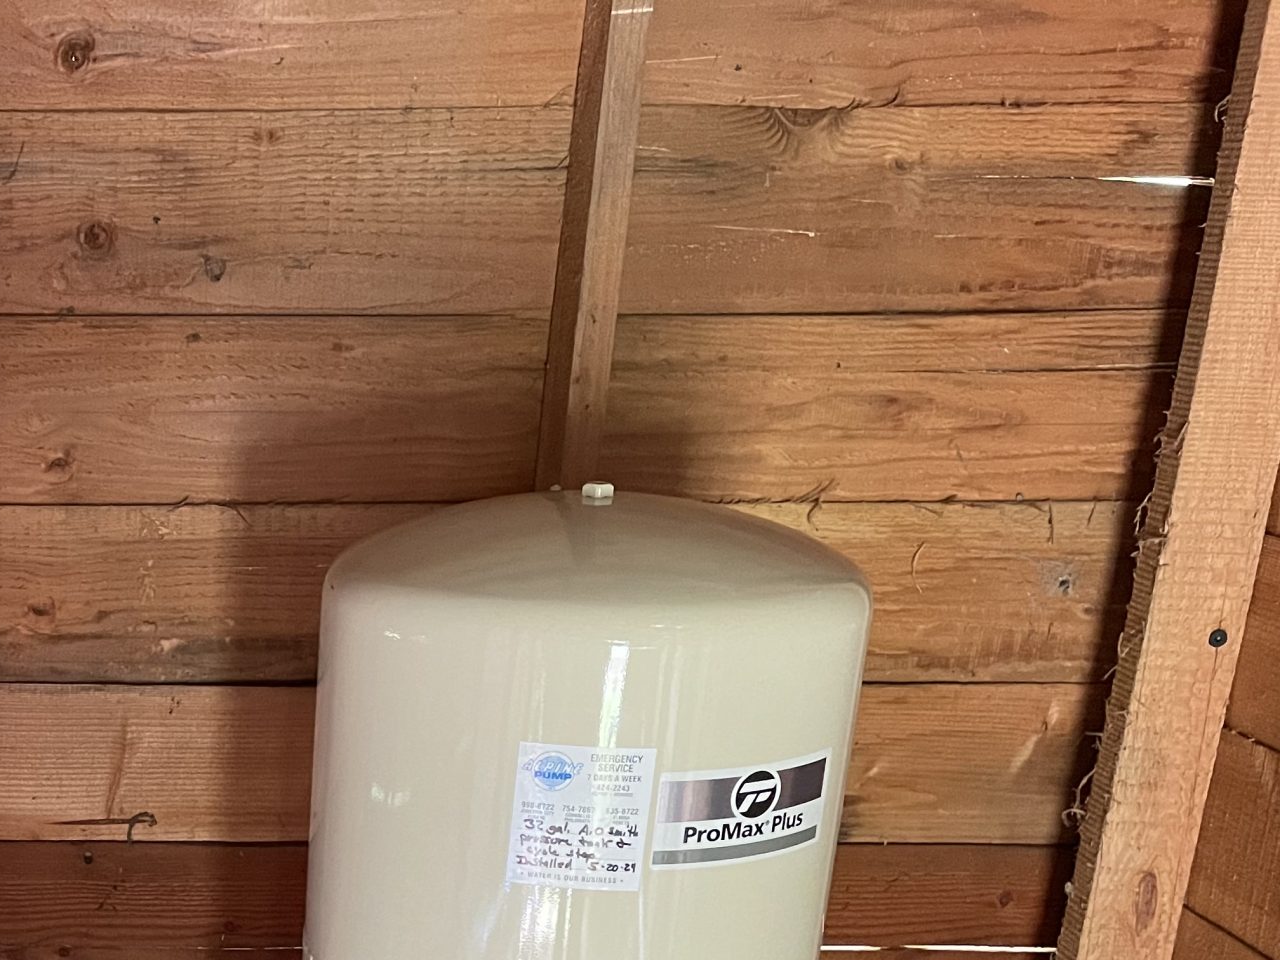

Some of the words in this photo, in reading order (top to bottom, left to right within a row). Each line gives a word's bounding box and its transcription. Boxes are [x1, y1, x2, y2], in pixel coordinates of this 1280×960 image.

[590, 753, 644, 763] EMERGENCY
[522, 758, 584, 774] ALPINE
[597, 763, 634, 773] SERVICE
[534, 770, 572, 780] PUMP
[593, 774, 613, 782] DAYS
[621, 775, 642, 783] WEEK
[523, 818, 544, 830] 32
[682, 822, 765, 844] ProMax
[771, 812, 803, 833] Plus
[565, 847, 596, 863] stop
[527, 871, 552, 879] WATER
[563, 874, 579, 882] OUR
[581, 876, 617, 884] BUSINESS
